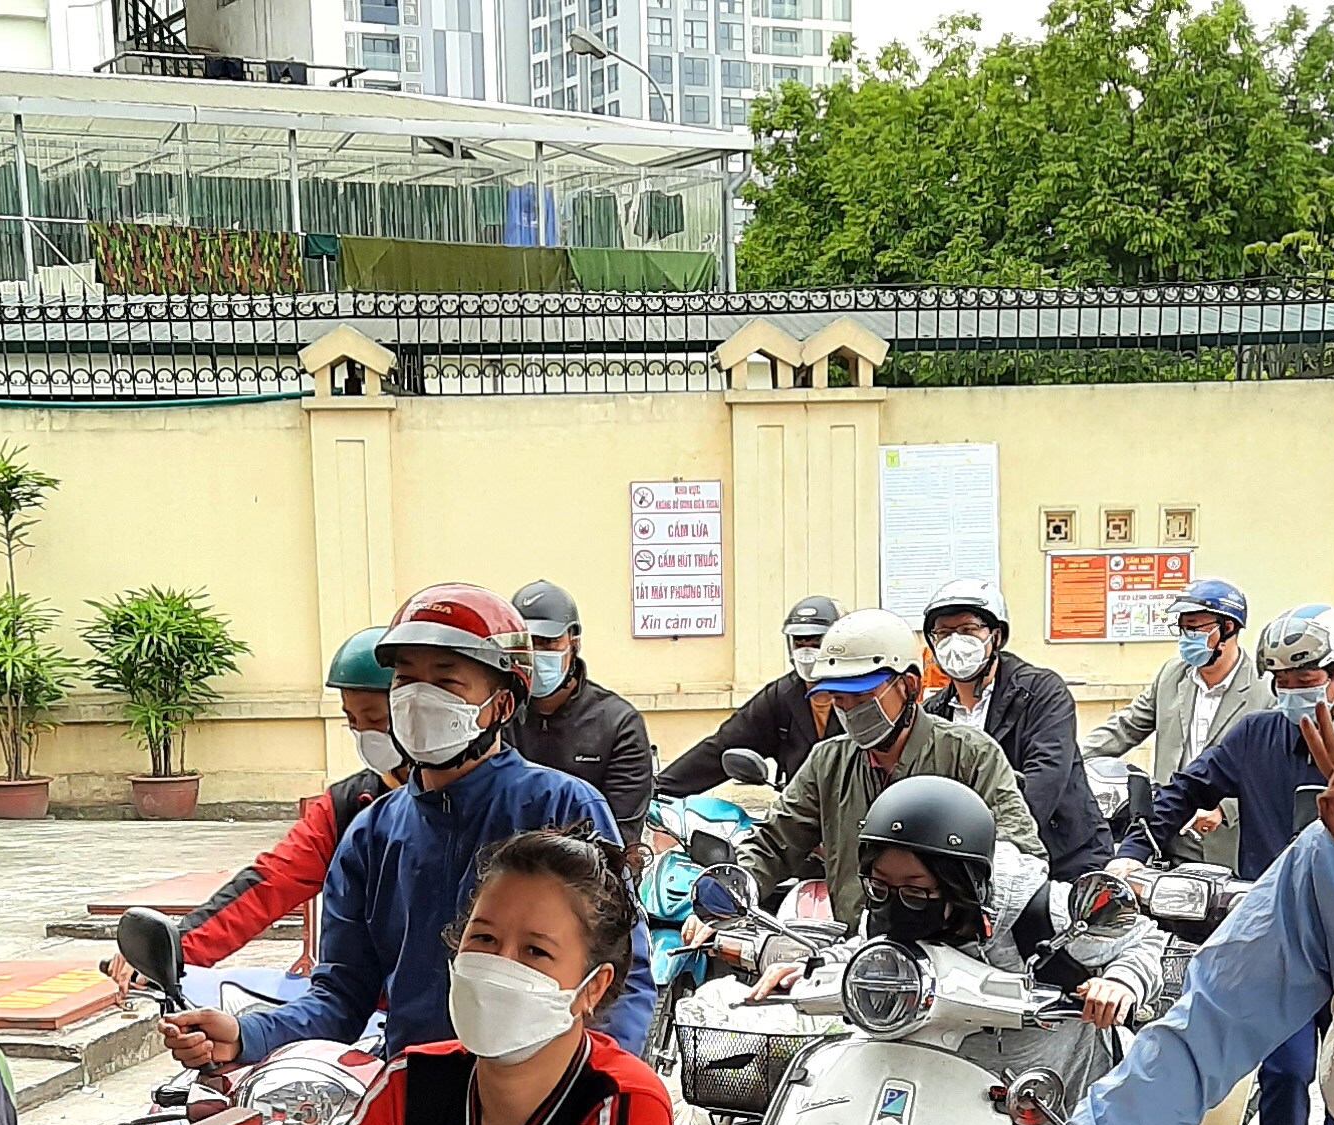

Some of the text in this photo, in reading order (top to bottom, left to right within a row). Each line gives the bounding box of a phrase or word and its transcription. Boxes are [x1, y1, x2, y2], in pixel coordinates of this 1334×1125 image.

[668, 519, 688, 537] CẤM
[658, 549, 675, 567] CẤM
[640, 614, 661, 630] Xin
[665, 614, 691, 630] cảm
